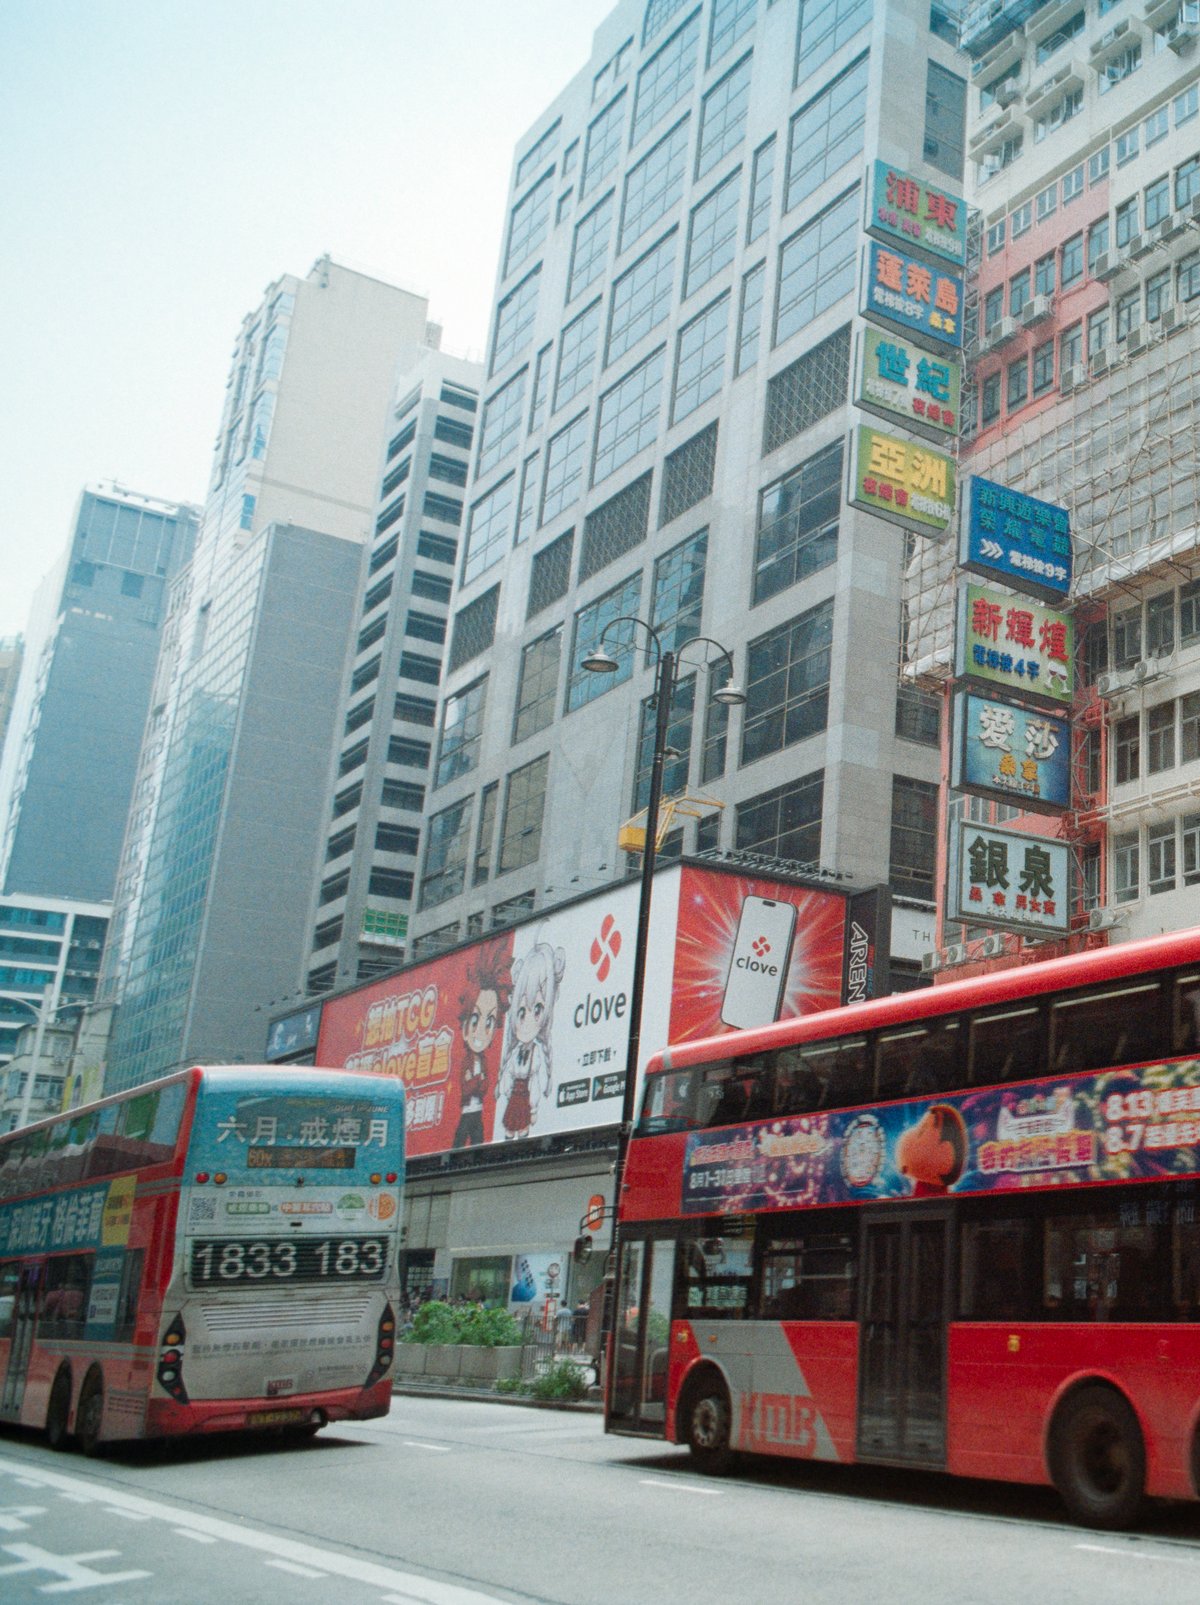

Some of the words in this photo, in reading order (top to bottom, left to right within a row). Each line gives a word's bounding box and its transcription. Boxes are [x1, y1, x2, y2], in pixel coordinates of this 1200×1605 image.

[885, 170, 959, 232] 浦東
[876, 248, 959, 316] 蓬萊島
[874, 340, 951, 402] 世紀
[868, 434, 947, 499] 亞洲
[972, 597, 1070, 662] 新輝煌
[968, 835, 1055, 899] 銀泉
[736, 956, 779, 978] clove
[573, 992, 627, 1029] clove
[196, 1242, 297, 1280] 1833
[314, 1240, 384, 1276] 183
